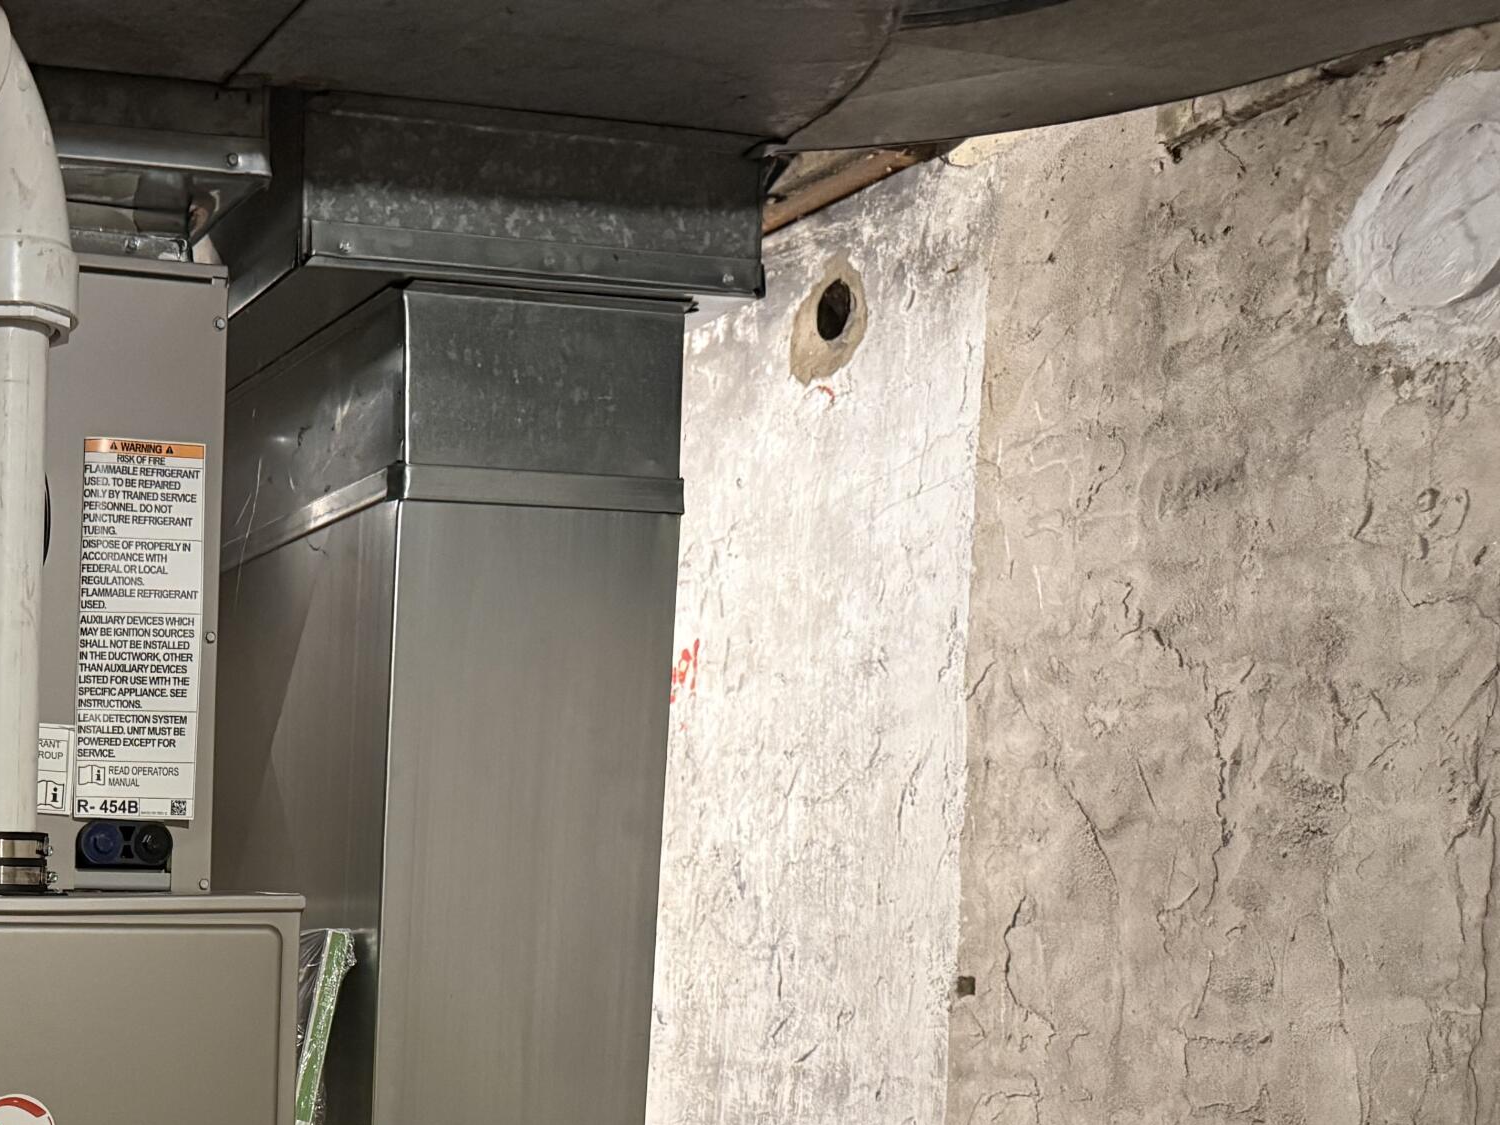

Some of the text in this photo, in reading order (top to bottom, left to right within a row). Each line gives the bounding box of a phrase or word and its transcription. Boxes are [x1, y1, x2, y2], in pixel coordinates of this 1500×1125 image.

[120, 442, 162, 454] WARNING
[117, 455, 166, 465] RISK OF FIRE
[84, 465, 200, 479] FLAMMABLE REFRIGERANT
[84, 477, 181, 490] USED. TO BE REPAIRED
[84, 489, 197, 503] ONLY BY TRAINED SERVICE
[140, 503, 152, 513] DO
[154, 504, 173, 514] NOT
[83, 513, 193, 527] PUNCTURE REFRIGERANT
[83, 525, 117, 535] TUBING.
[82, 539, 191, 552] DISPOSE OF PROPERLY IN
[81, 551, 168, 563] ACCORDANCE WITH
[81, 563, 168, 575] FEDERAL OR LOCAL
[81, 575, 145, 586] REGULATIONS.
[81, 588, 198, 600] FLAMMABLE REFRIGERANT
[81, 600, 106, 609] USED.
[80, 615, 195, 626] AUXILIARY DEVICES WHICH
[80, 627, 195, 639] MAY BE IGNITION SOURCES
[79, 639, 190, 650] SHALL NOT BE INSTALLED
[79, 651, 88, 660] IN
[89, 651, 107, 660] THE
[162, 653, 193, 662] OTHER
[79, 663, 188, 674] THAN AUXILIARY DEVICES
[78, 675, 190, 686] LISTED FOR USE WITH THE
[78, 687, 116, 696] SPECIFIC
[169, 688, 188, 698] SEE
[78, 698, 143, 709] INSTRUCTIONS.
[78, 713, 188, 724] LEAK DETECTION SYSTEM
[78, 725, 186, 736] INSTALLED. UNIT MUST BE
[77, 737, 177, 748] POWERED EXCEPT FOR
[108, 765, 180, 776] READ OPERATORS
[108, 778, 140, 787] MANUAL
[99, 799, 139, 814] 454B
